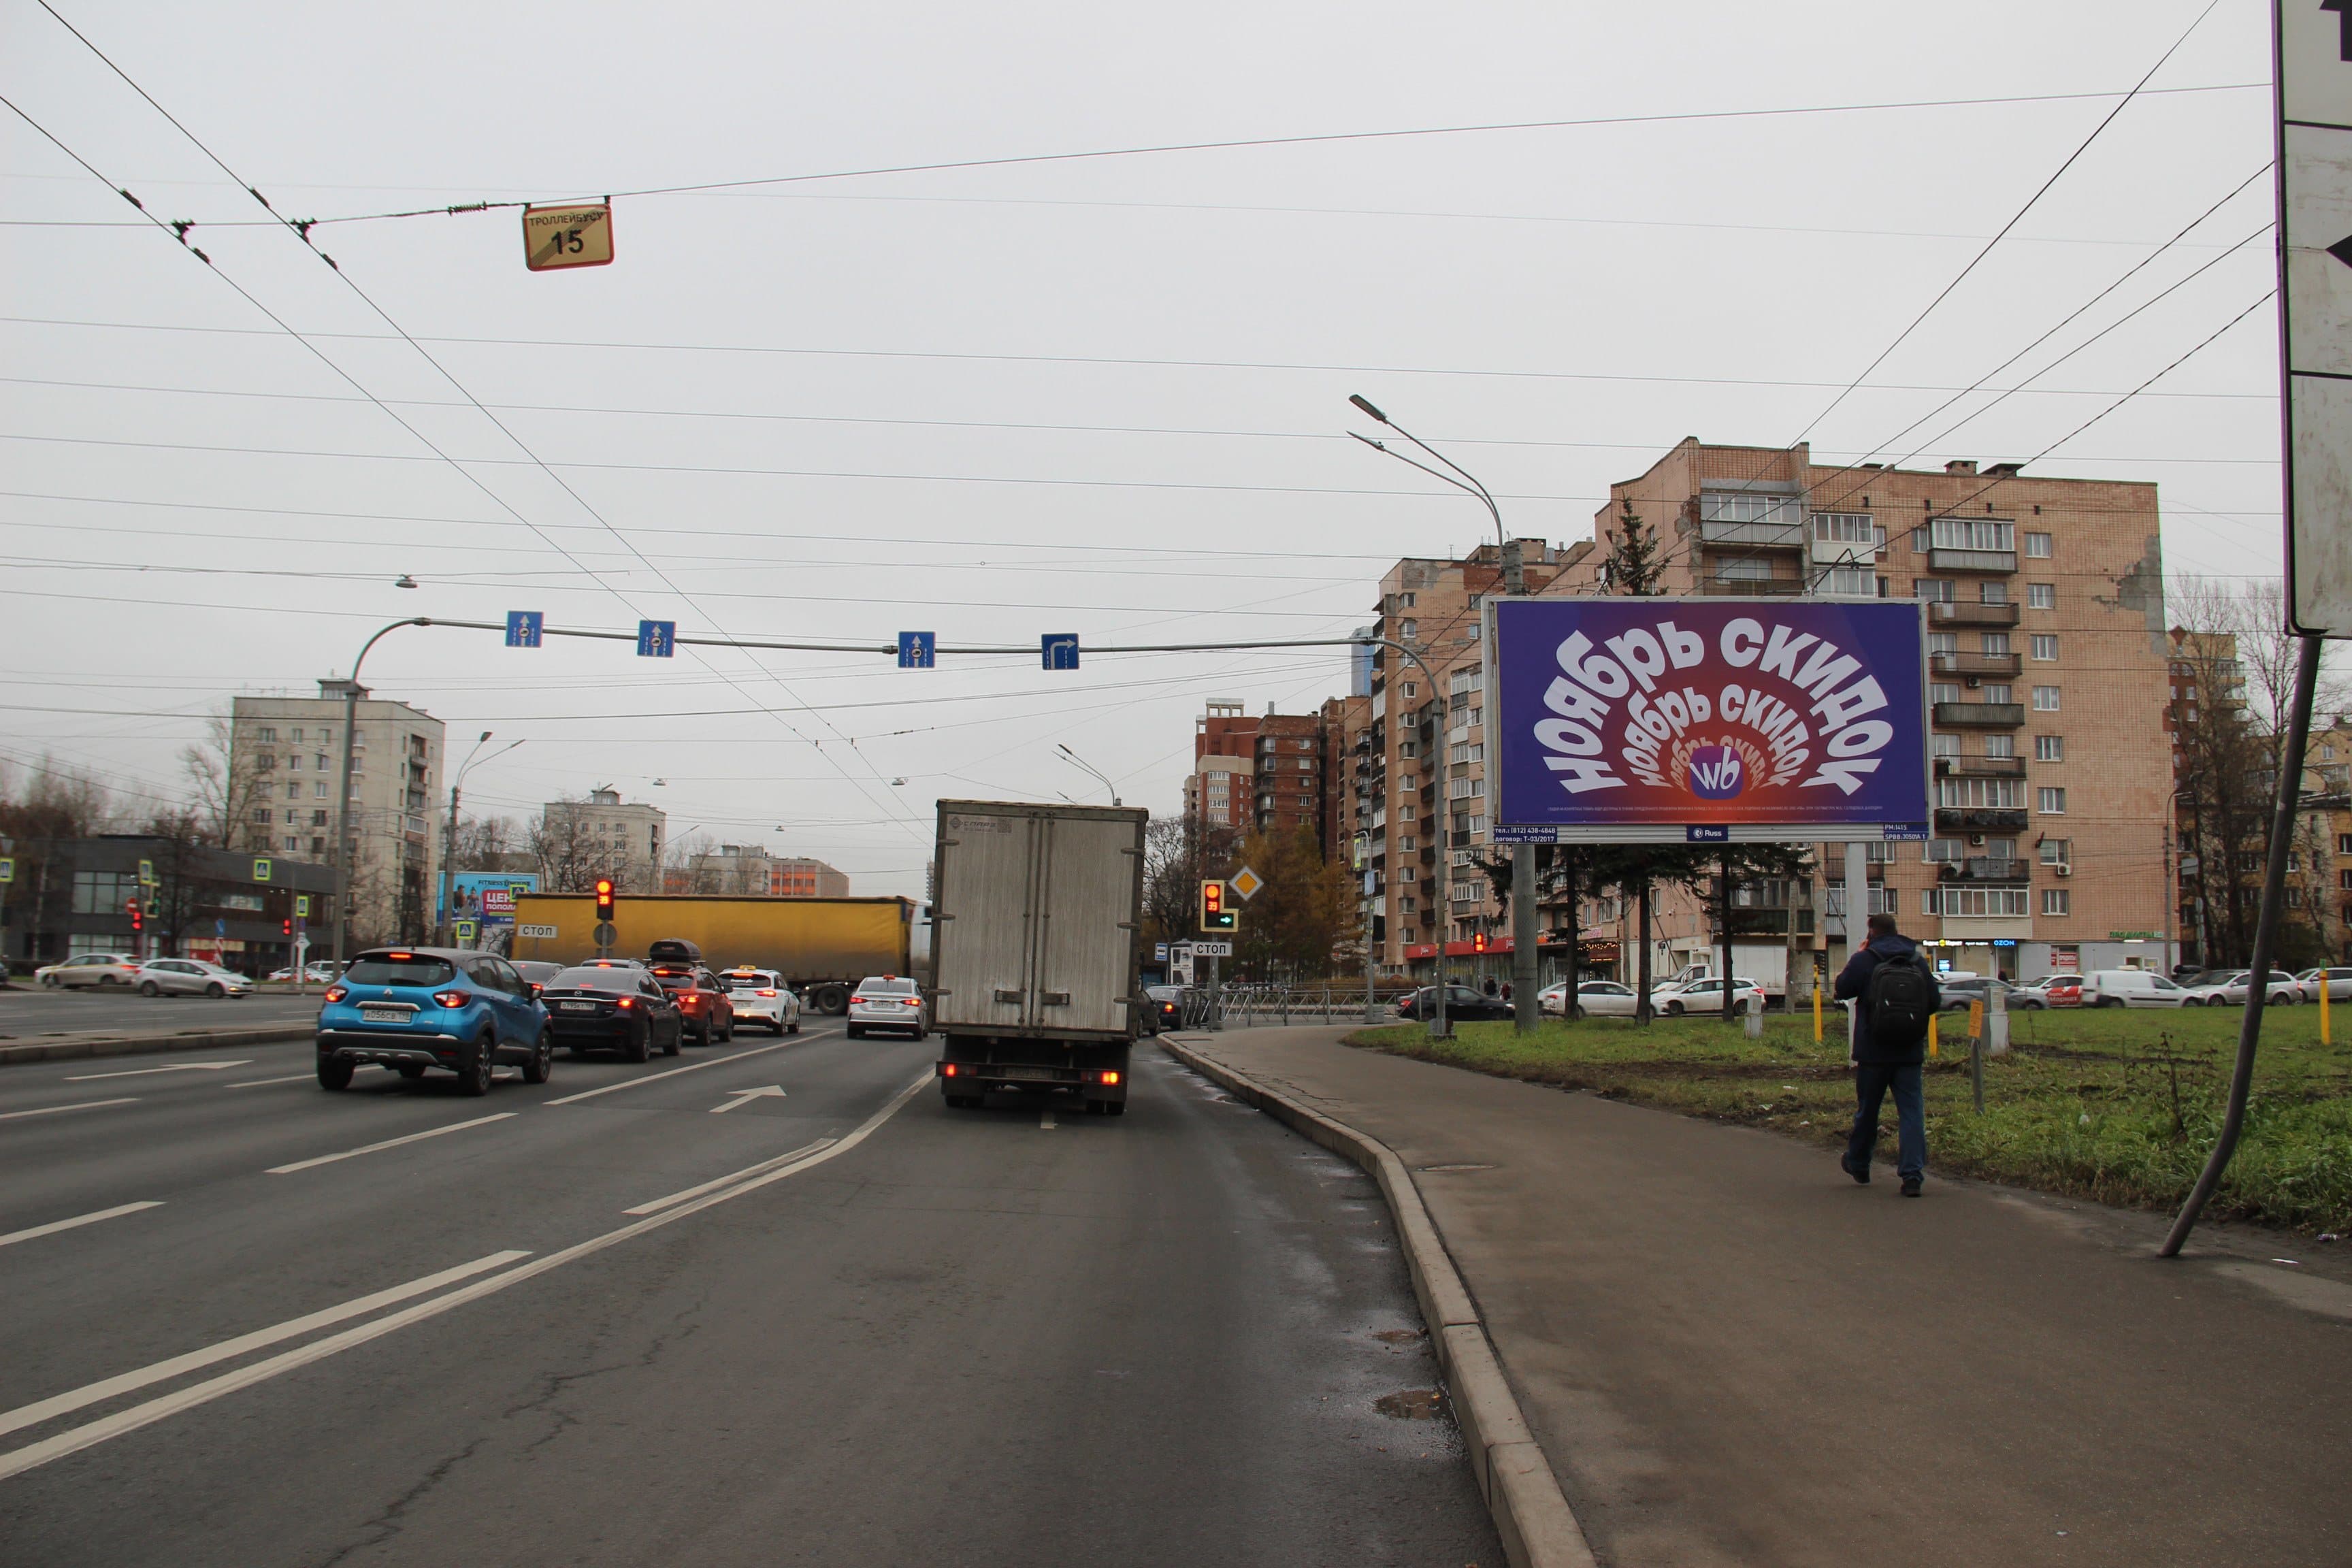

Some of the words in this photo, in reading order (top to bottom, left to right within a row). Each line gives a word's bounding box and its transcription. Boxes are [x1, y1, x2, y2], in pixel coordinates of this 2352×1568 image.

[551, 229, 584, 255] 15
[487, 892, 510, 903] ЦЕН
[523, 926, 553, 936] СТОП
[1196, 944, 1226, 954] СТОП
